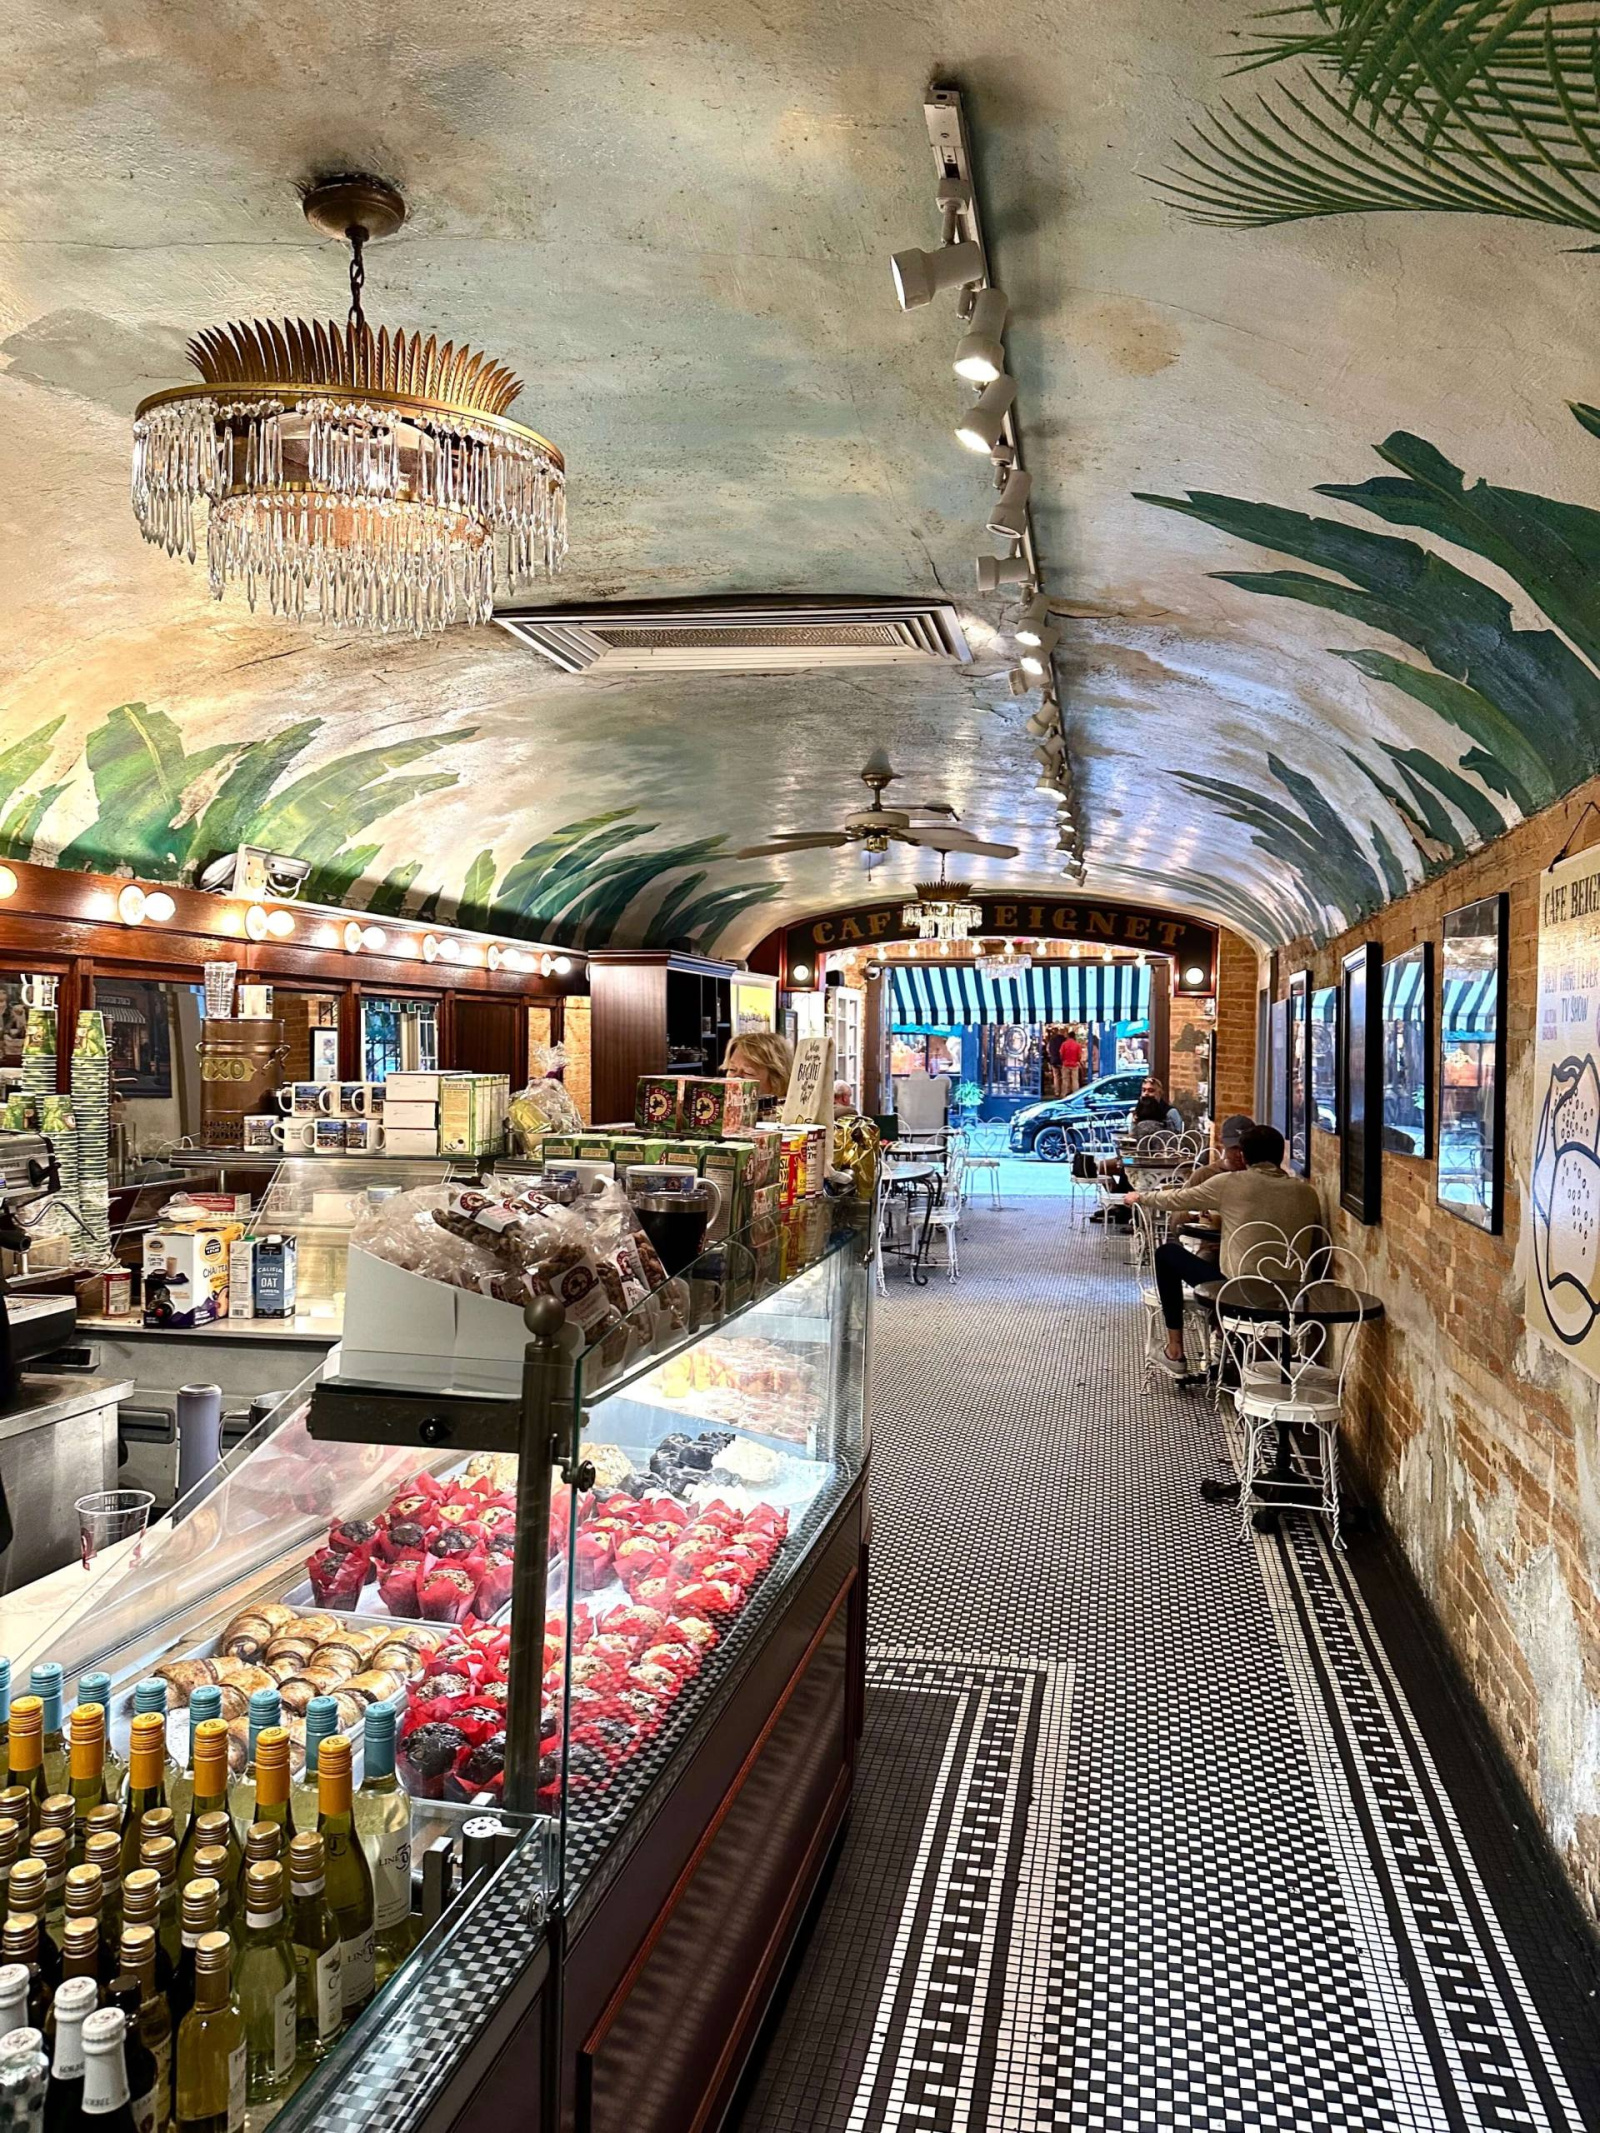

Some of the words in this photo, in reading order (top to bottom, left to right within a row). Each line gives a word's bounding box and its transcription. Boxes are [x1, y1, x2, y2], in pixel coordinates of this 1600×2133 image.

[1544, 885, 1568, 928] CAFE
[994, 904, 1186, 947] EIGNET
[654, 1088, 671, 1099] CAFE
[701, 1091, 717, 1101] CAFE
[203, 1267, 216, 1278] CHAI
[261, 1277, 278, 1288] OAT
[379, 1852, 399, 1867] LINE
